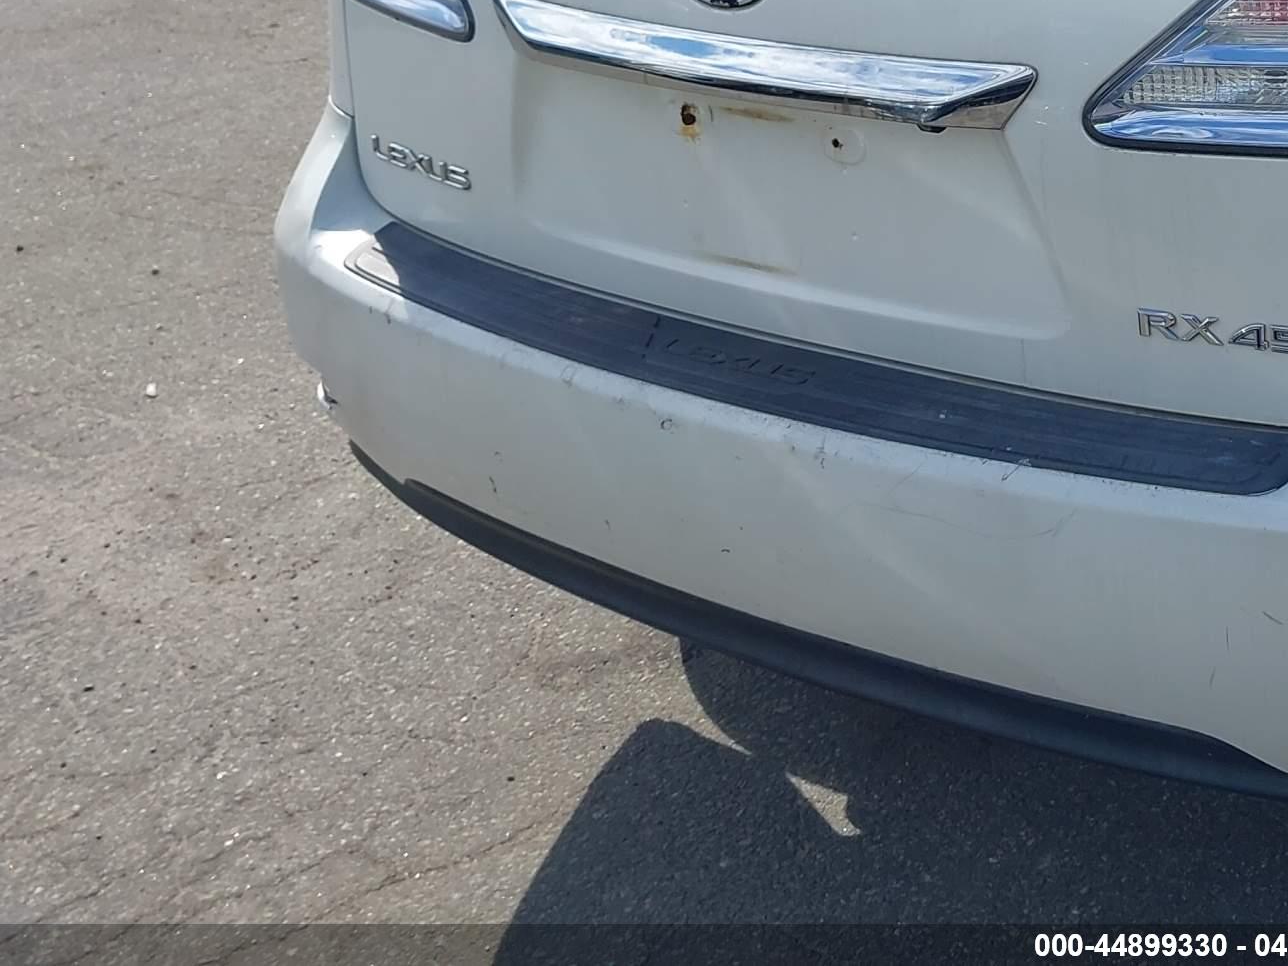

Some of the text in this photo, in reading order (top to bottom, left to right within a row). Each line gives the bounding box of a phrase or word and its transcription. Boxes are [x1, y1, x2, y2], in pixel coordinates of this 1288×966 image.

[371, 134, 472, 190] LEXUS
[1137, 308, 1224, 347] RX
[665, 338, 816, 385] LEXUS
